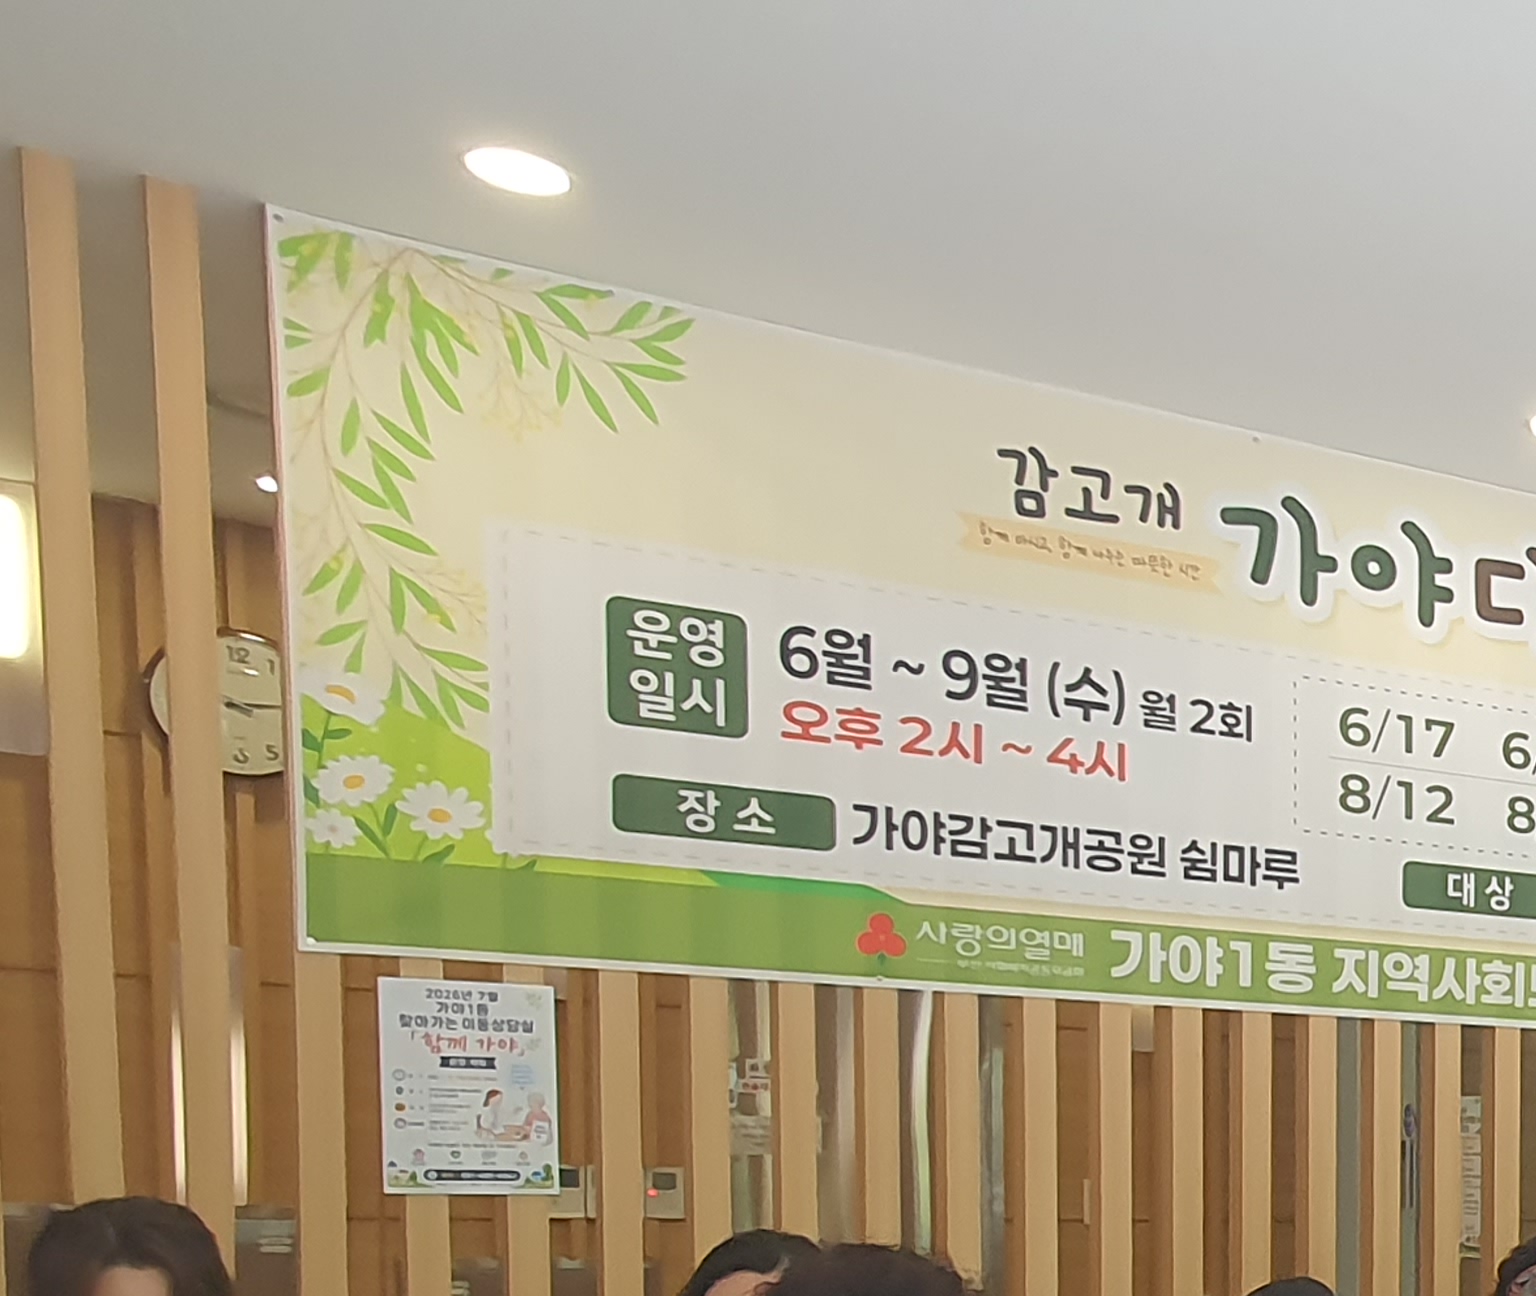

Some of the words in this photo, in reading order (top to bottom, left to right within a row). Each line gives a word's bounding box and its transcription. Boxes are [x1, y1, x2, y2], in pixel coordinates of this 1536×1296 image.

[996, 445, 1182, 531] 감고개
[626, 608, 725, 668] 운영
[629, 668, 726, 727] 일시
[779, 625, 873, 690] 6월
[941, 648, 1029, 712] 9월
[1047, 660, 1126, 726] (수)
[1138, 690, 1177, 732] 월
[1188, 698, 1252, 743] 2회
[265, 744, 280, 762] 5
[780, 699, 884, 750] 오후
[898, 715, 983, 765] 2시
[1046, 737, 1127, 782] 4시
[1337, 706, 1456, 759] 6/17
[1337, 773, 1456, 826] 8/12
[852, 803, 1167, 878] 가야감고개공원
[1179, 838, 1300, 890] 쉼마루
[915, 920, 1085, 961] 사랑의열매
[1108, 928, 1318, 996] 가야1동
